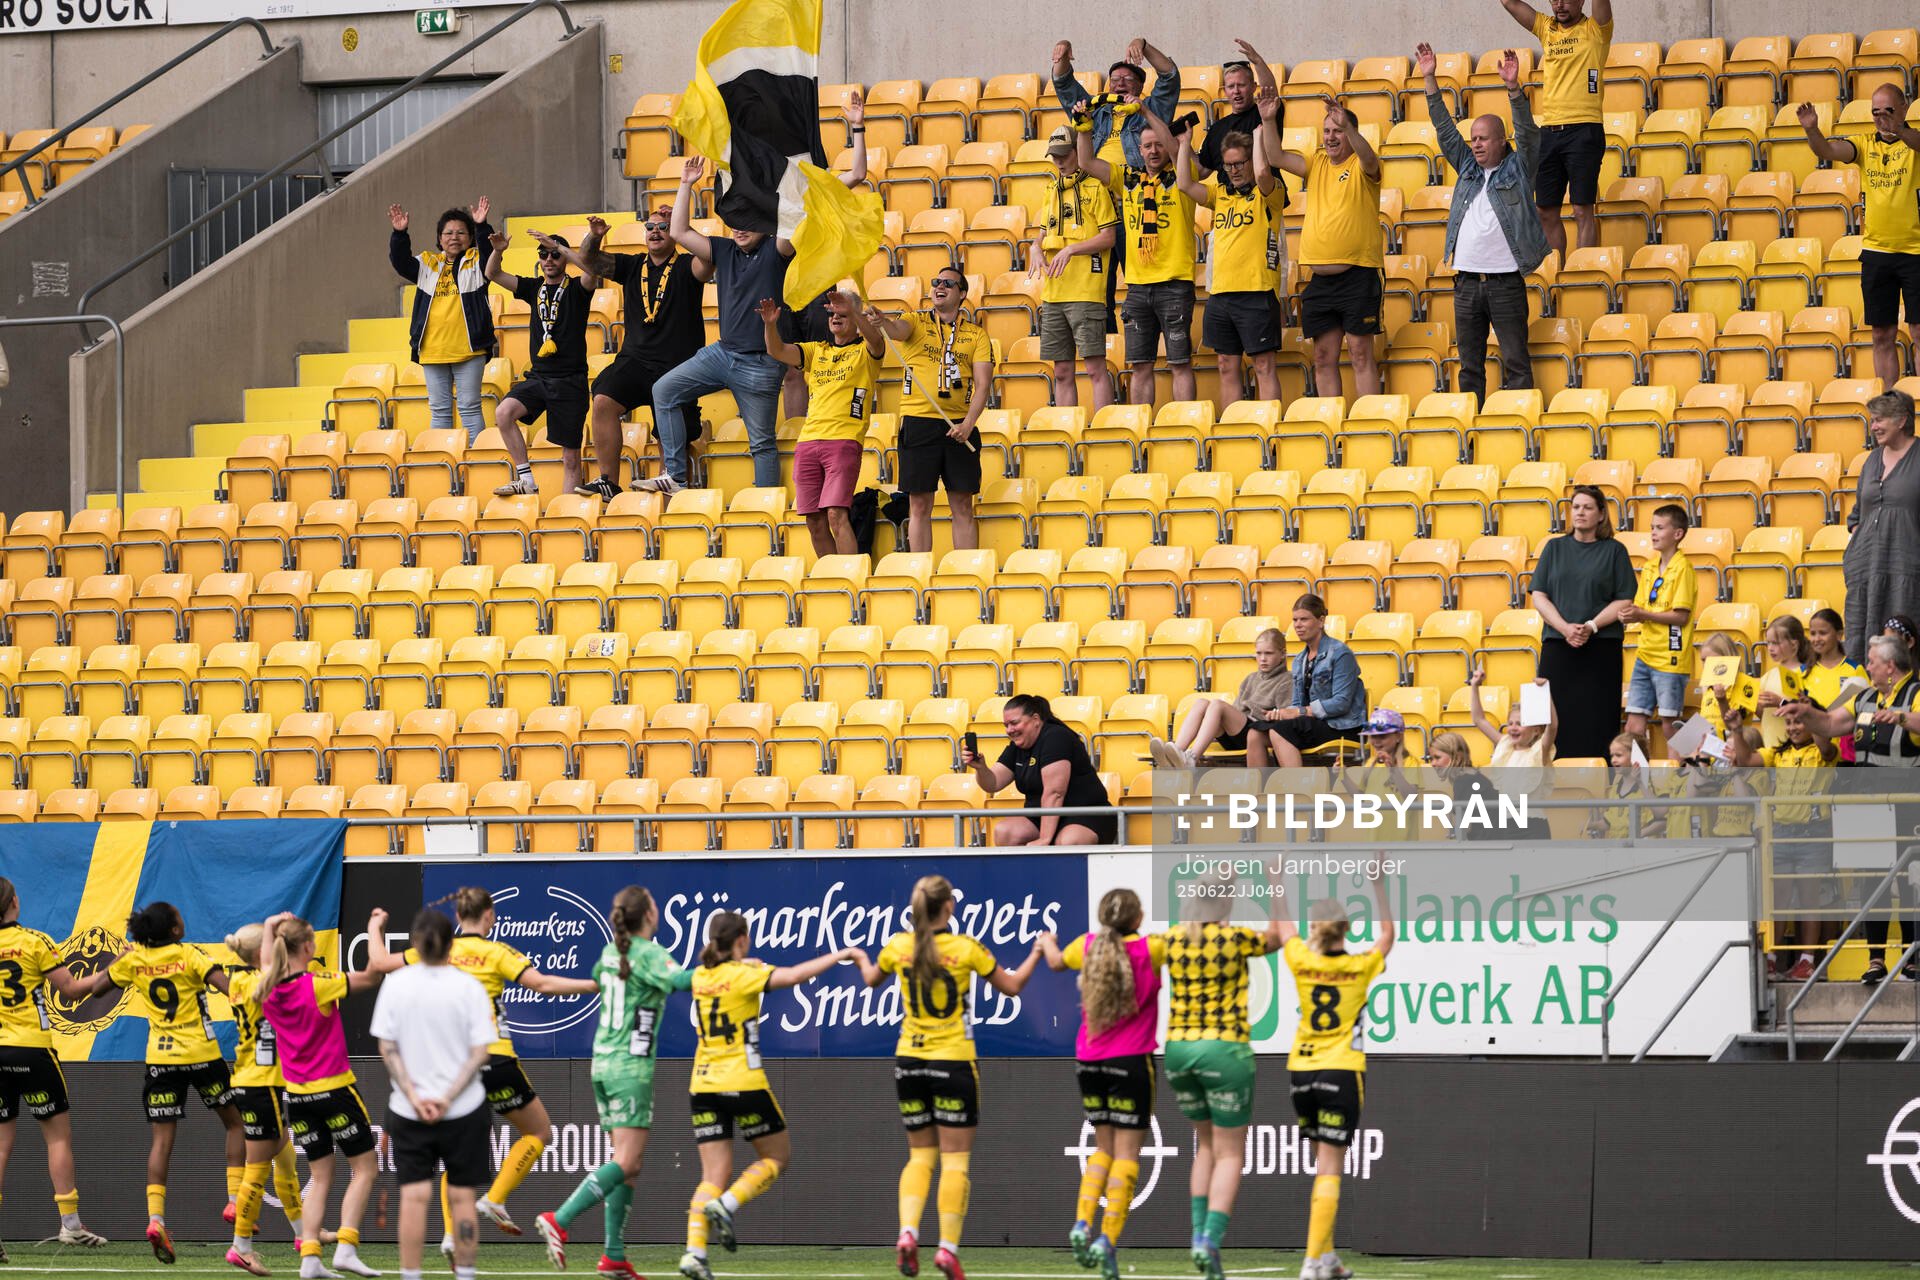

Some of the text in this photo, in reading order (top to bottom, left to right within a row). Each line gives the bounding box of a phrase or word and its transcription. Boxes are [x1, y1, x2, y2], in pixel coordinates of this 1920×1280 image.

[57, 0, 153, 25] SOCK
[1129, 207, 1171, 230] els
[1216, 207, 1254, 230] ellos
[487, 912, 586, 943] jömarkens
[546, 945, 579, 969] och
[150, 978, 180, 1023] 9
[781, 972, 905, 1032] Smid
[903, 966, 960, 1019] 10
[1310, 984, 1341, 1032] 8
[1366, 965, 1616, 1043] gverk AB
[695, 997, 738, 1047] 14
